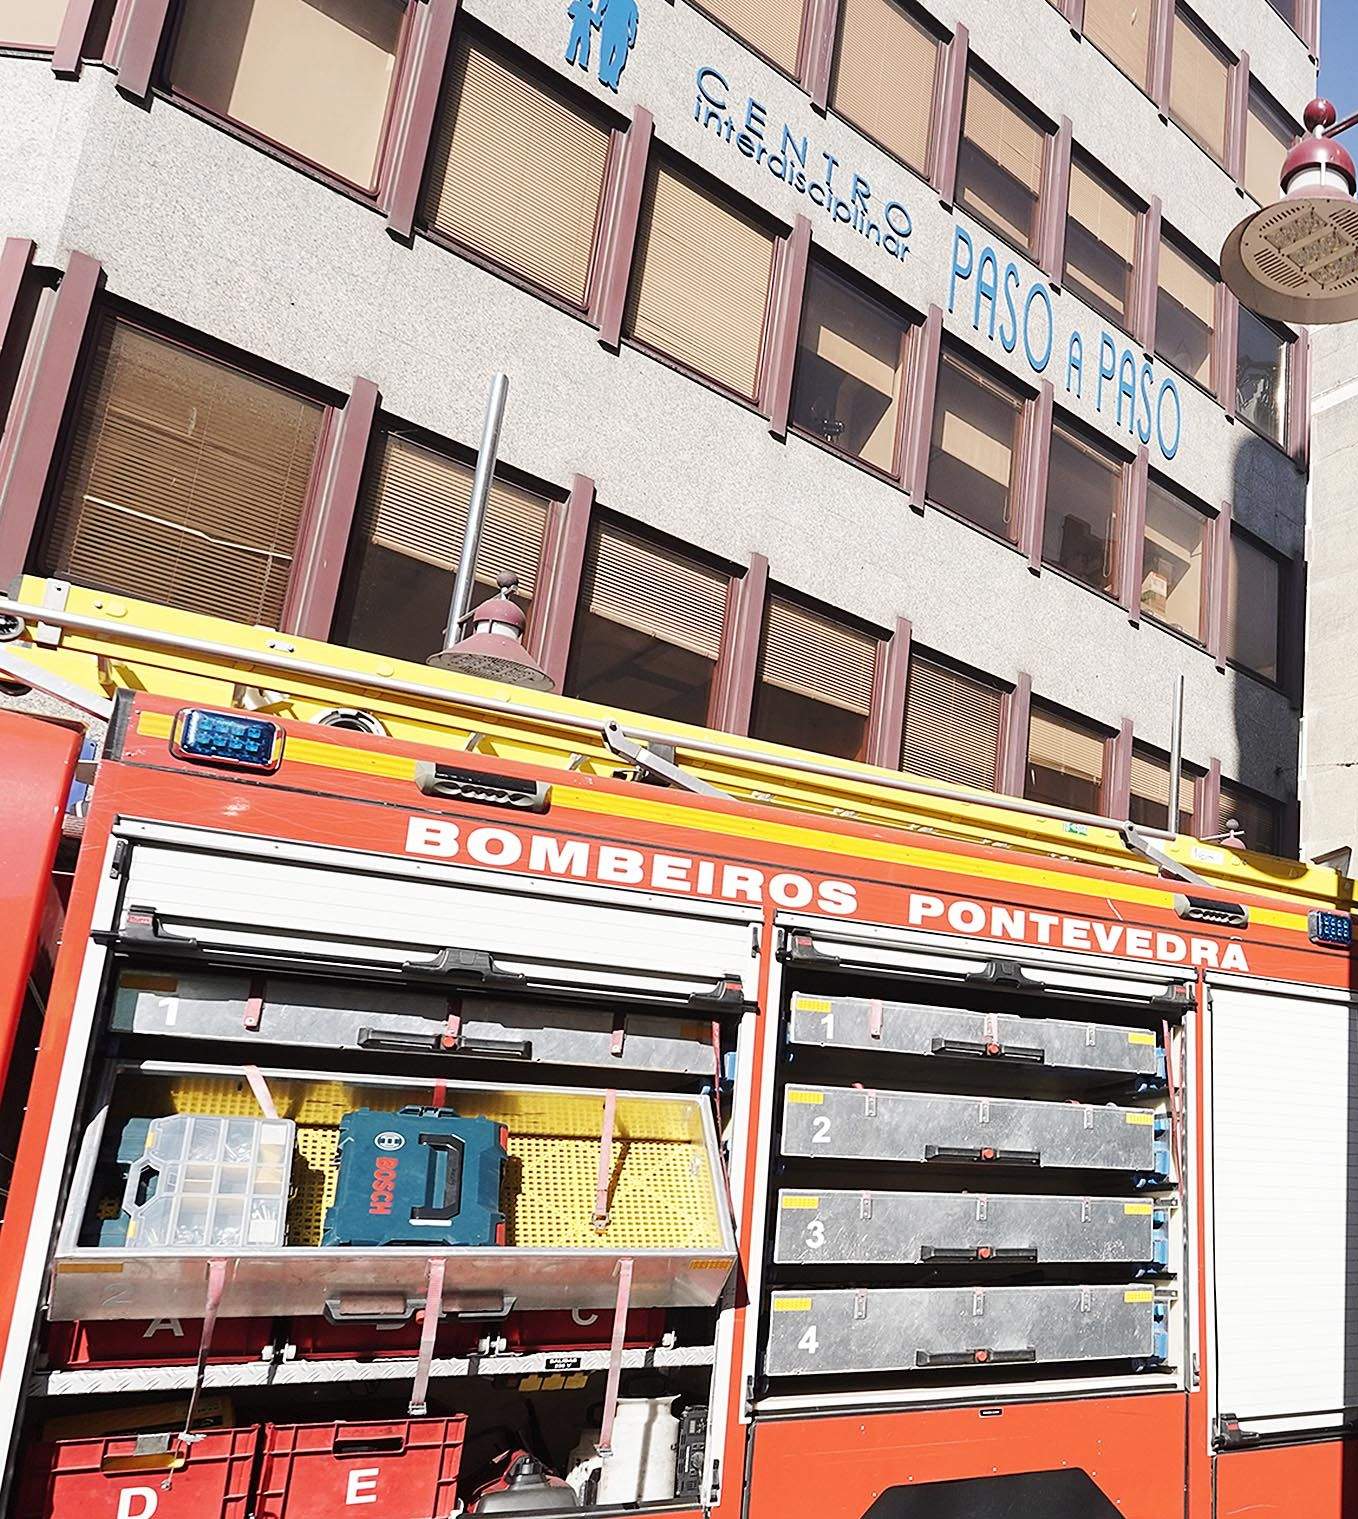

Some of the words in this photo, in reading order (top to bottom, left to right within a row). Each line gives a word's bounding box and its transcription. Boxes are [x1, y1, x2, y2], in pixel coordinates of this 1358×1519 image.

[696, 66, 914, 239] CENTRO
[692, 96, 913, 264] interdisciplinar
[948, 225, 1055, 373] PASO
[1066, 331, 1083, 399] A
[1097, 333, 1182, 461] PASO
[405, 816, 858, 915] BOMBEIROS
[908, 892, 1250, 972] PONTEVEDRA
[158, 997, 180, 1026] 1
[820, 1013, 836, 1040] 1
[811, 1116, 832, 1144] 2
[369, 1157, 400, 1215] BOSCH
[805, 1220, 827, 1249] 3
[798, 1326, 820, 1355] 4
[116, 1486, 158, 1519] D
[345, 1467, 380, 1505] E
